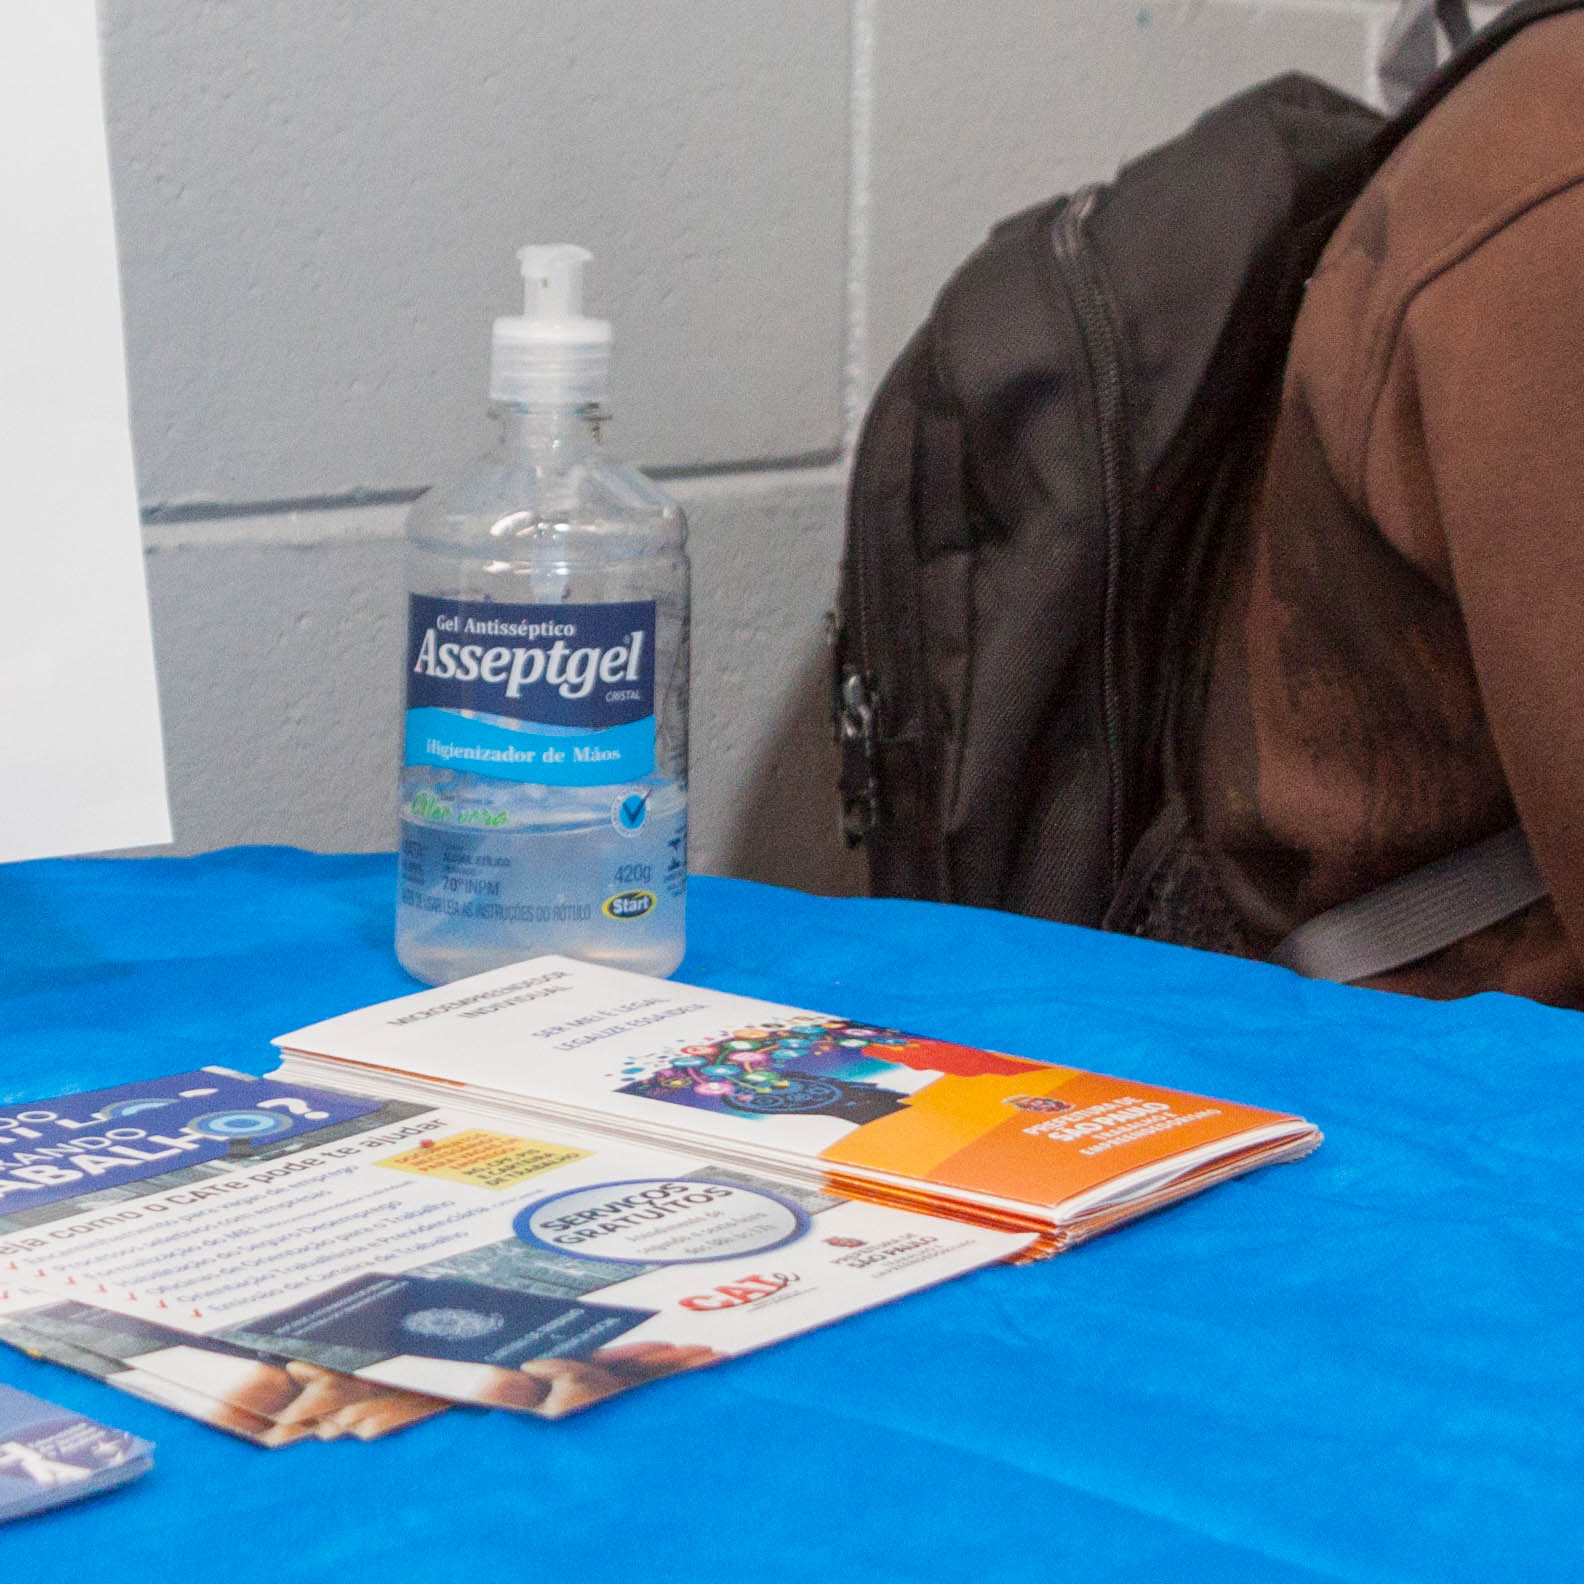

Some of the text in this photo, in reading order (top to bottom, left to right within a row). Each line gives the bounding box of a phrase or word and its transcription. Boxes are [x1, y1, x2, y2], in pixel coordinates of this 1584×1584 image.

[436, 615, 576, 640] Gel Antisséptico
[414, 628, 646, 699] Asseptgel
[425, 739, 536, 763] Higienizador
[542, 745, 566, 763] de
[614, 864, 652, 885] 420g
[612, 893, 651, 915] Start
[388, 970, 572, 1026] MICROEMPREENDEDOR
[458, 985, 574, 1020] INDIVIDUAL
[1021, 1098, 1125, 1136] PREFEITURA
[1048, 1100, 1171, 1144] SÃO PAULO
[48, 1209, 144, 1242] como
[143, 1203, 170, 1219] o
[248, 1153, 327, 1185] pode
[324, 1146, 362, 1161] te
[358, 1117, 450, 1149] ajudar
[538, 1182, 691, 1234] SERVIÇOS
[551, 1185, 735, 1246] GRATUÍTOS
